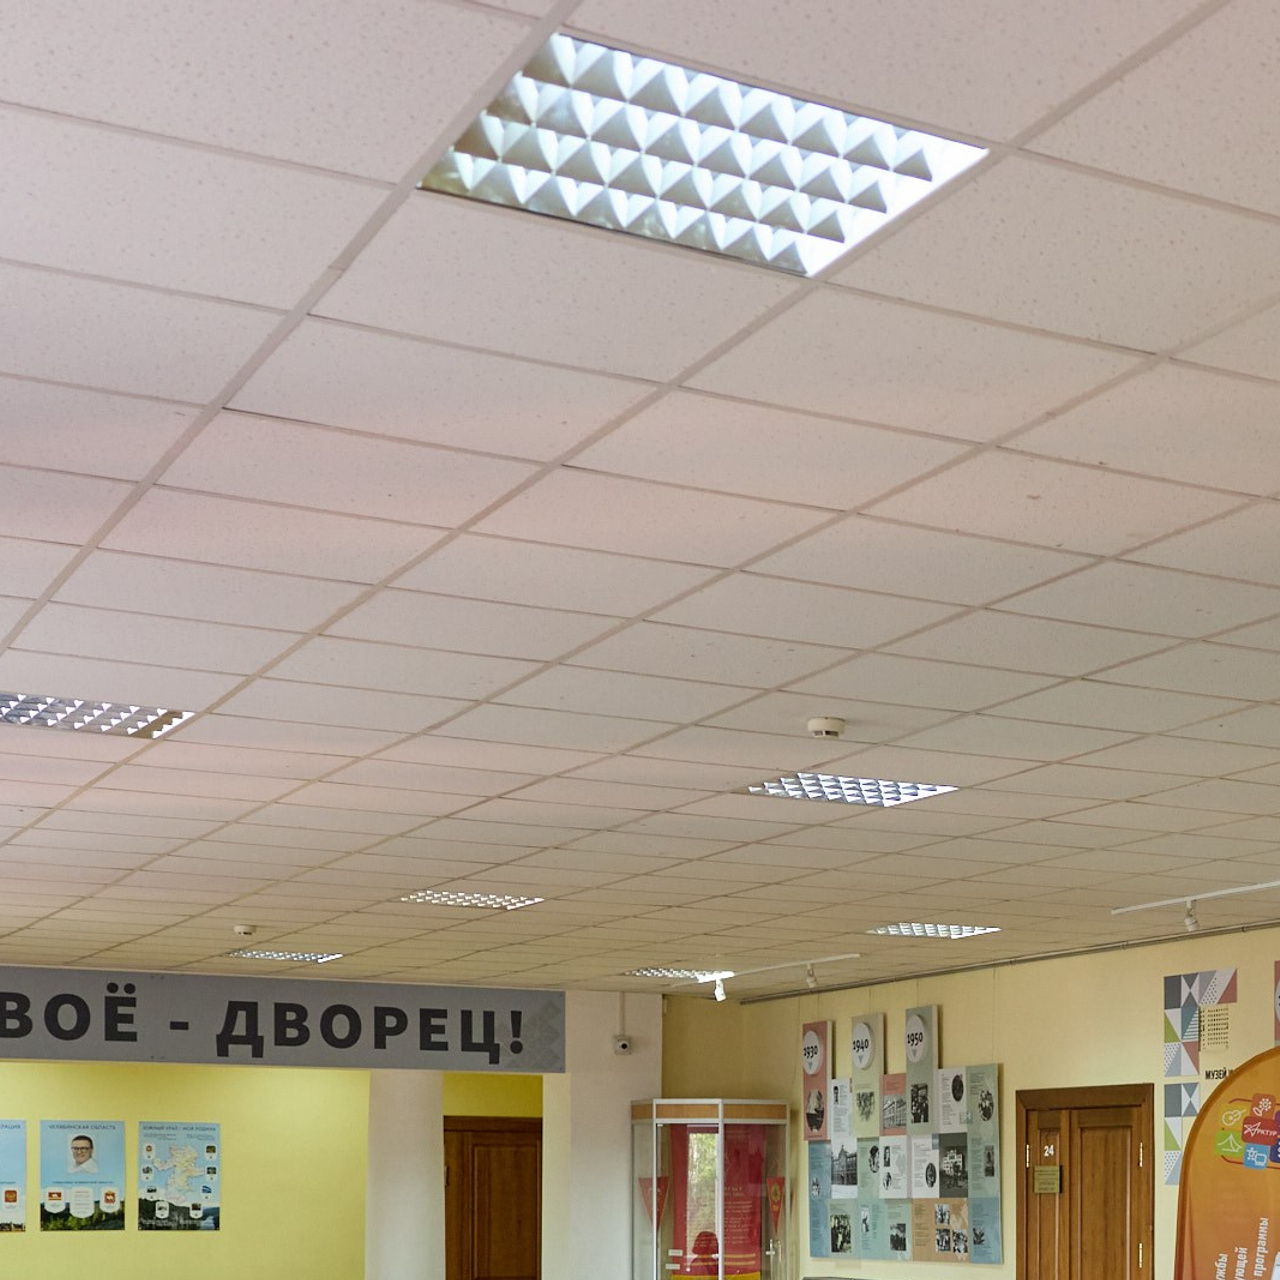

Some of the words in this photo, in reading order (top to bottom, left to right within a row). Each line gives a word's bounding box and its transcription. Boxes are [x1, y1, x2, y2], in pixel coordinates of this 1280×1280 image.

[216, 1000, 523, 1064] ДВОРЕЦ!
[907, 1032, 923, 1046] 1950
[803, 1046, 818, 1059] 1930
[852, 1039, 869, 1053] 1940
[1044, 1144, 1054, 1157] 24
[1254, 1217, 1269, 1277] программы
